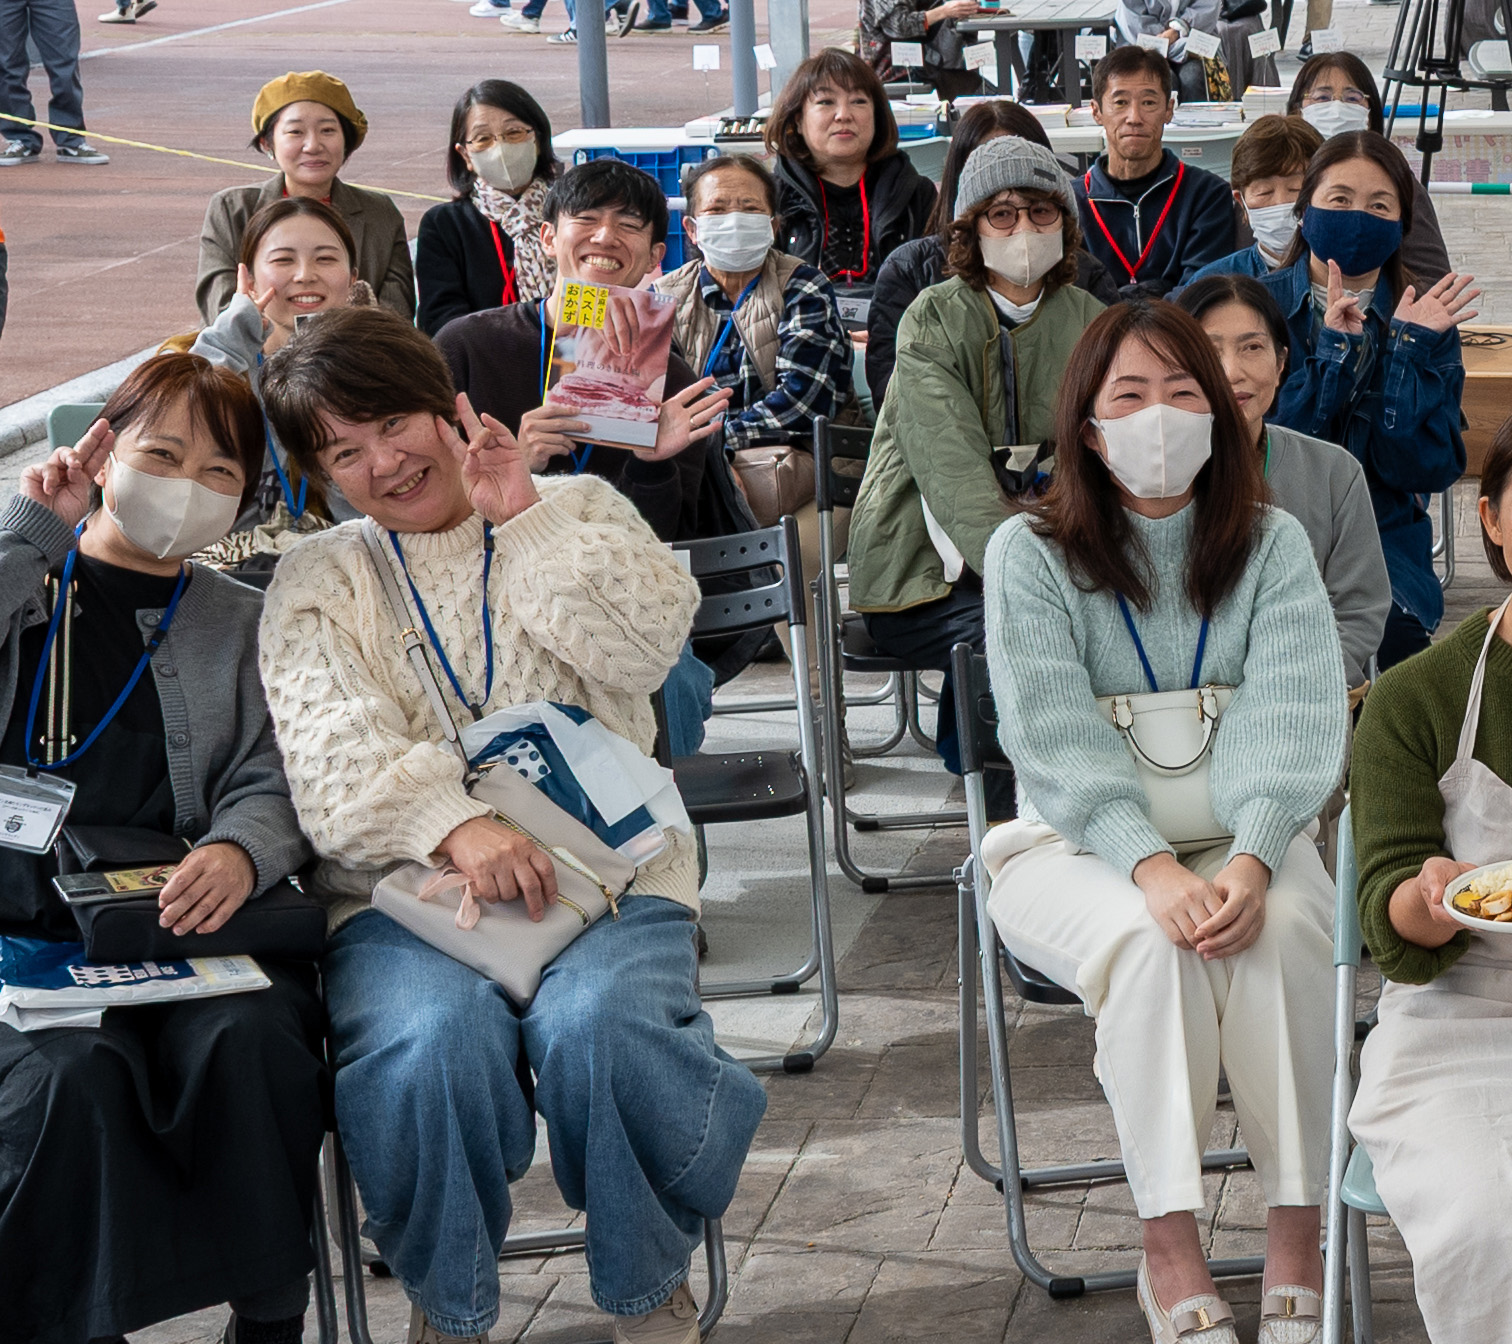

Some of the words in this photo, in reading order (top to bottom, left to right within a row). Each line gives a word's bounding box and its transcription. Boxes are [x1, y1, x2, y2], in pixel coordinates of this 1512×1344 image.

[564, 284, 580, 324] おかず
[581, 286, 597, 325] ベスト
